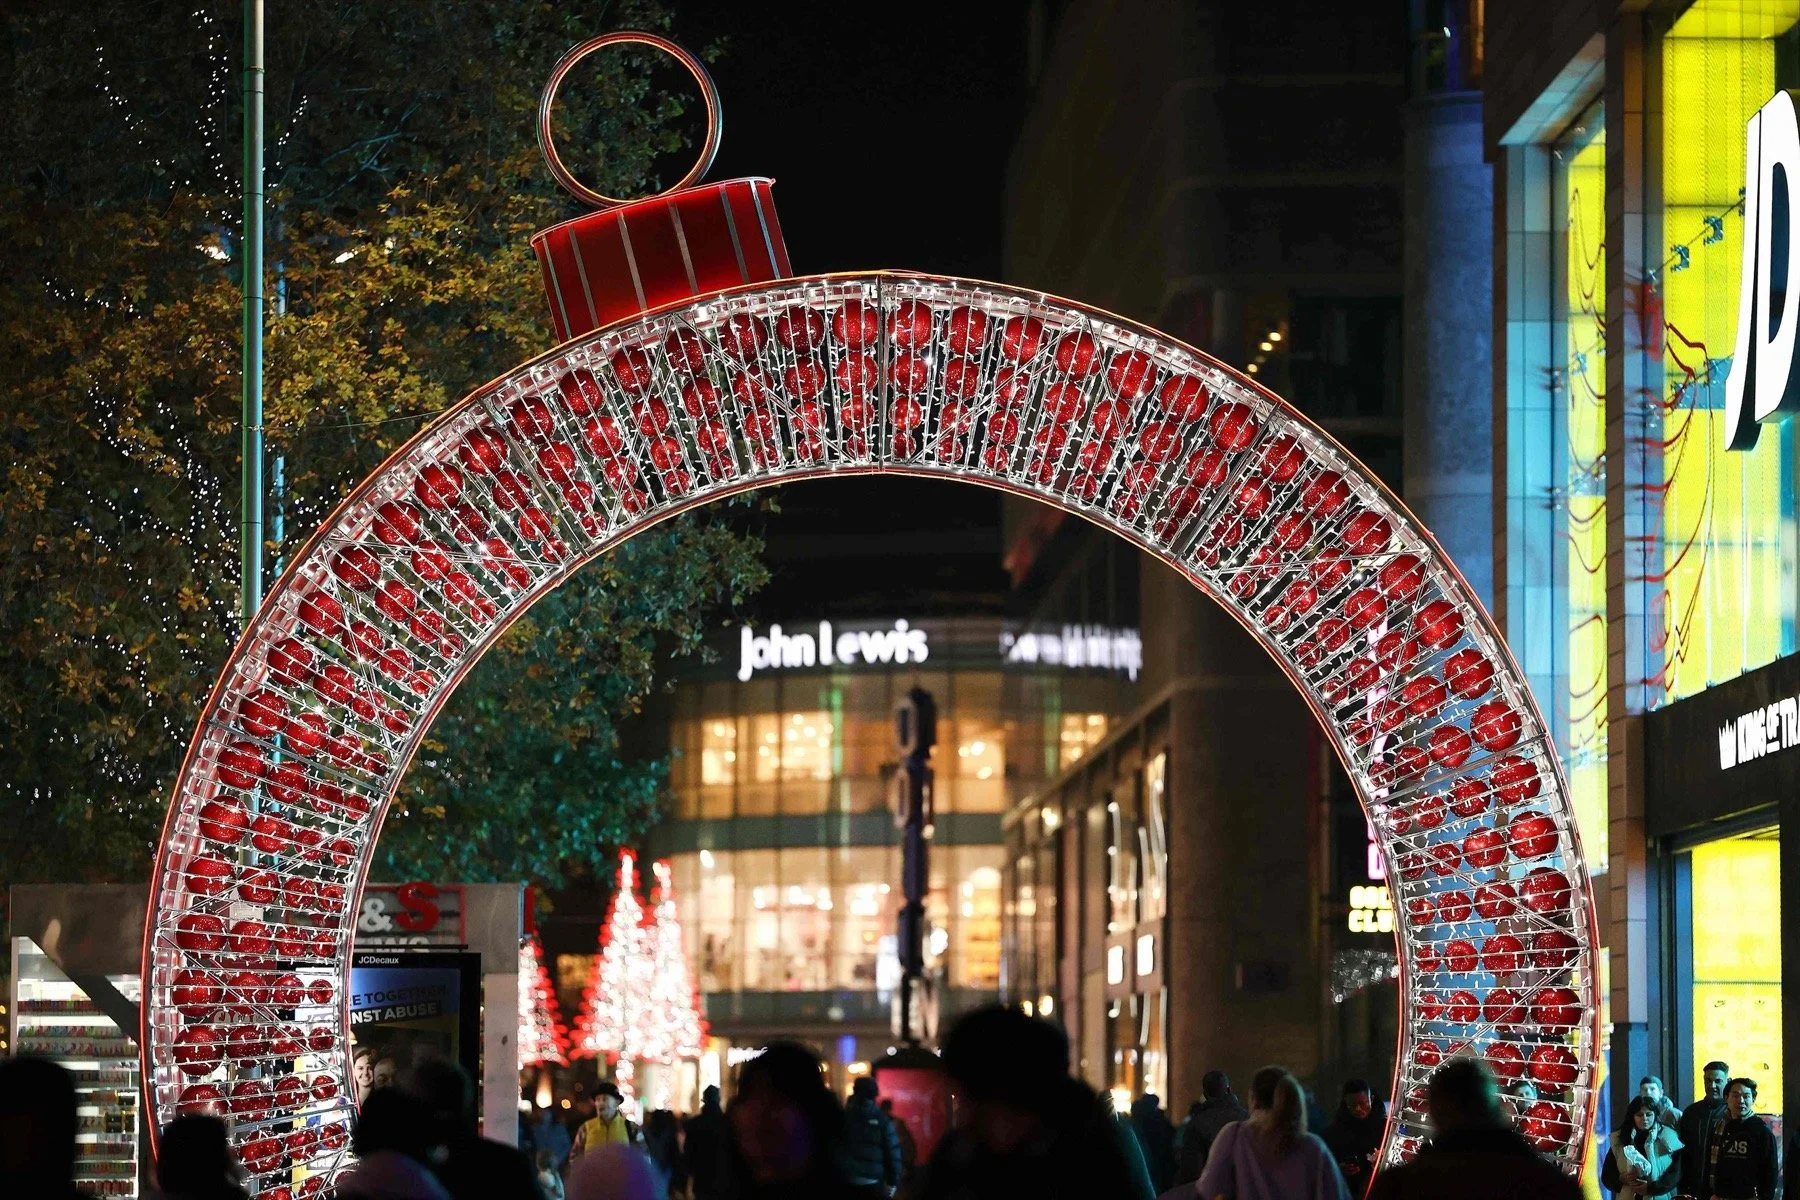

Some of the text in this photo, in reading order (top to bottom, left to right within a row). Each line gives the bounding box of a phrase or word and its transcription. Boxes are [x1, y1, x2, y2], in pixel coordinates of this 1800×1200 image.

[736, 618, 929, 682] John Lewis
[1737, 693, 1800, 764] KING OF TR
[1349, 910, 1396, 932] CLU
[358, 956, 399, 964] JCDecaux
[350, 984, 448, 1006] E TOGETHER
[350, 1009, 381, 1025] NST
[384, 1002, 437, 1021] ABUSE
